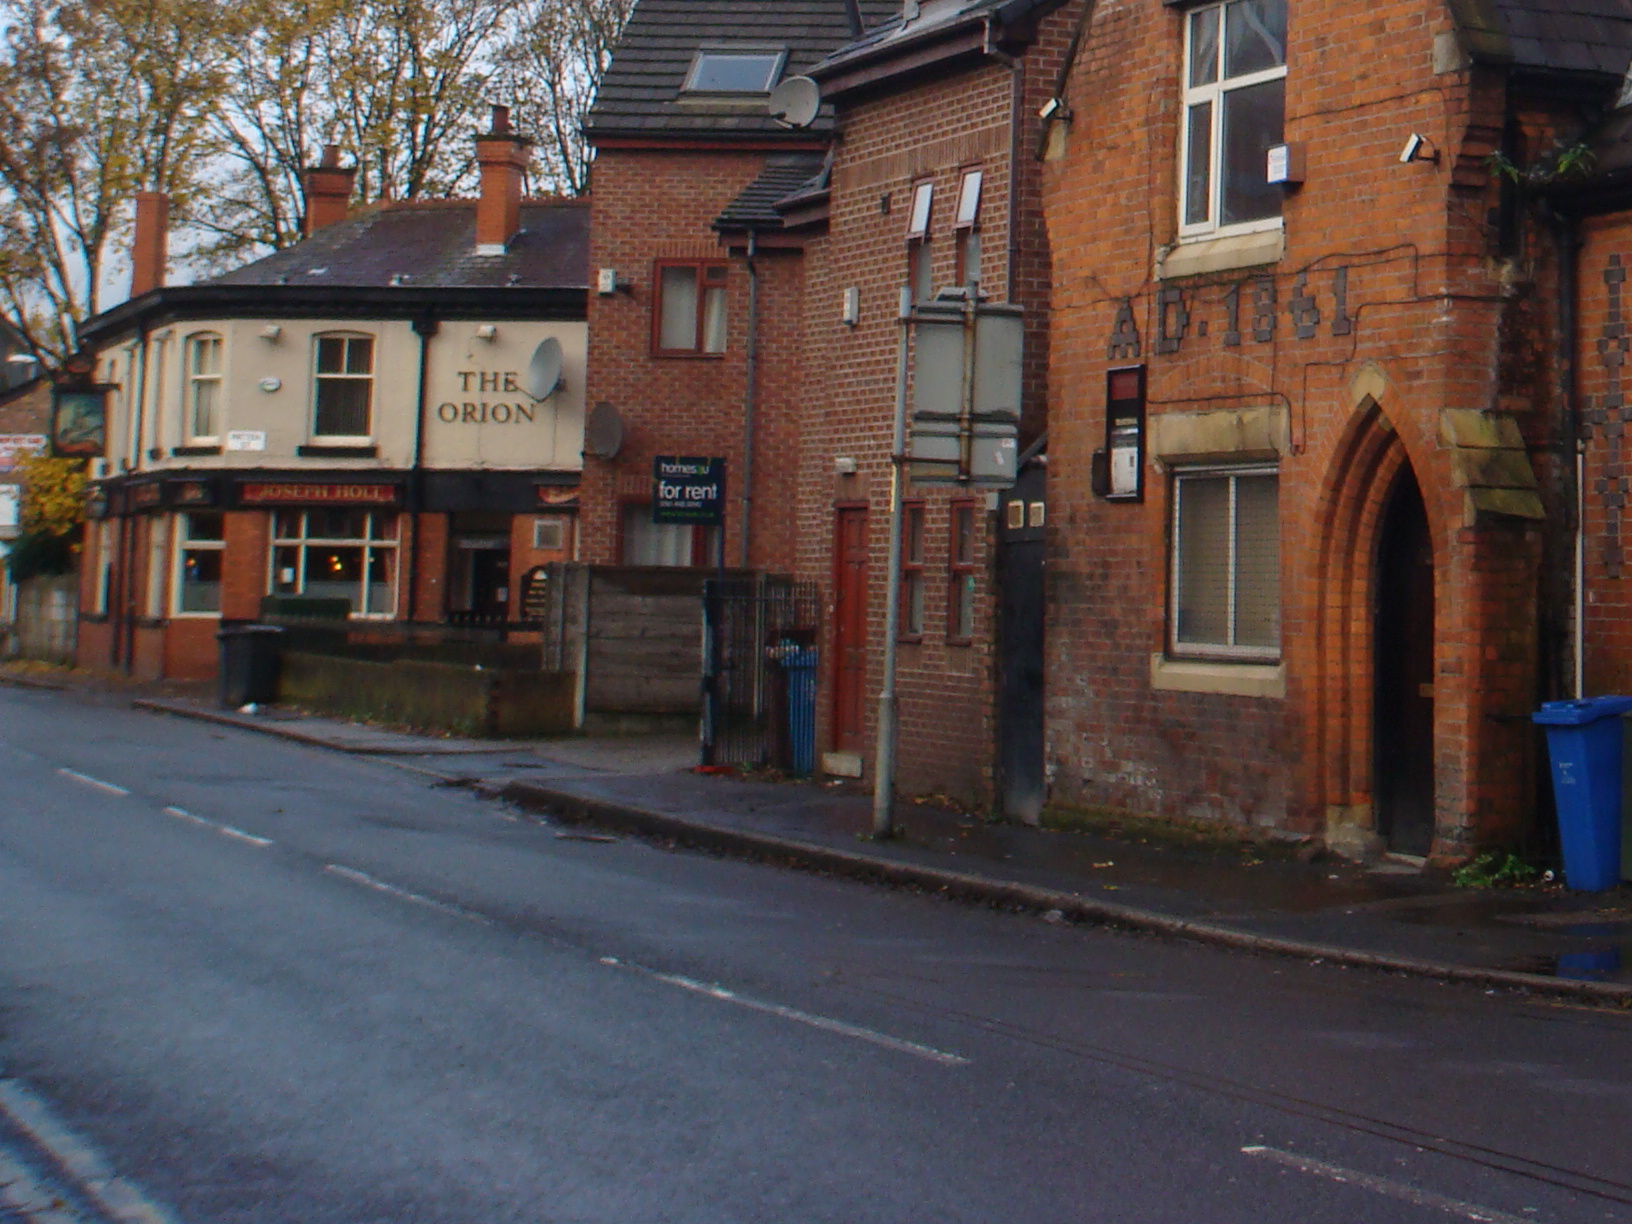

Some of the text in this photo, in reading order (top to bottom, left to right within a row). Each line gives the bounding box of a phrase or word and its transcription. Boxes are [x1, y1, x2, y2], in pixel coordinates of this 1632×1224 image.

[1223, 266, 1351, 347] 1861
[457, 371, 519, 392] THE
[438, 402, 536, 423] ORION
[260, 485, 381, 498] JOSEPH HOLT
[659, 480, 717, 500] for rent
